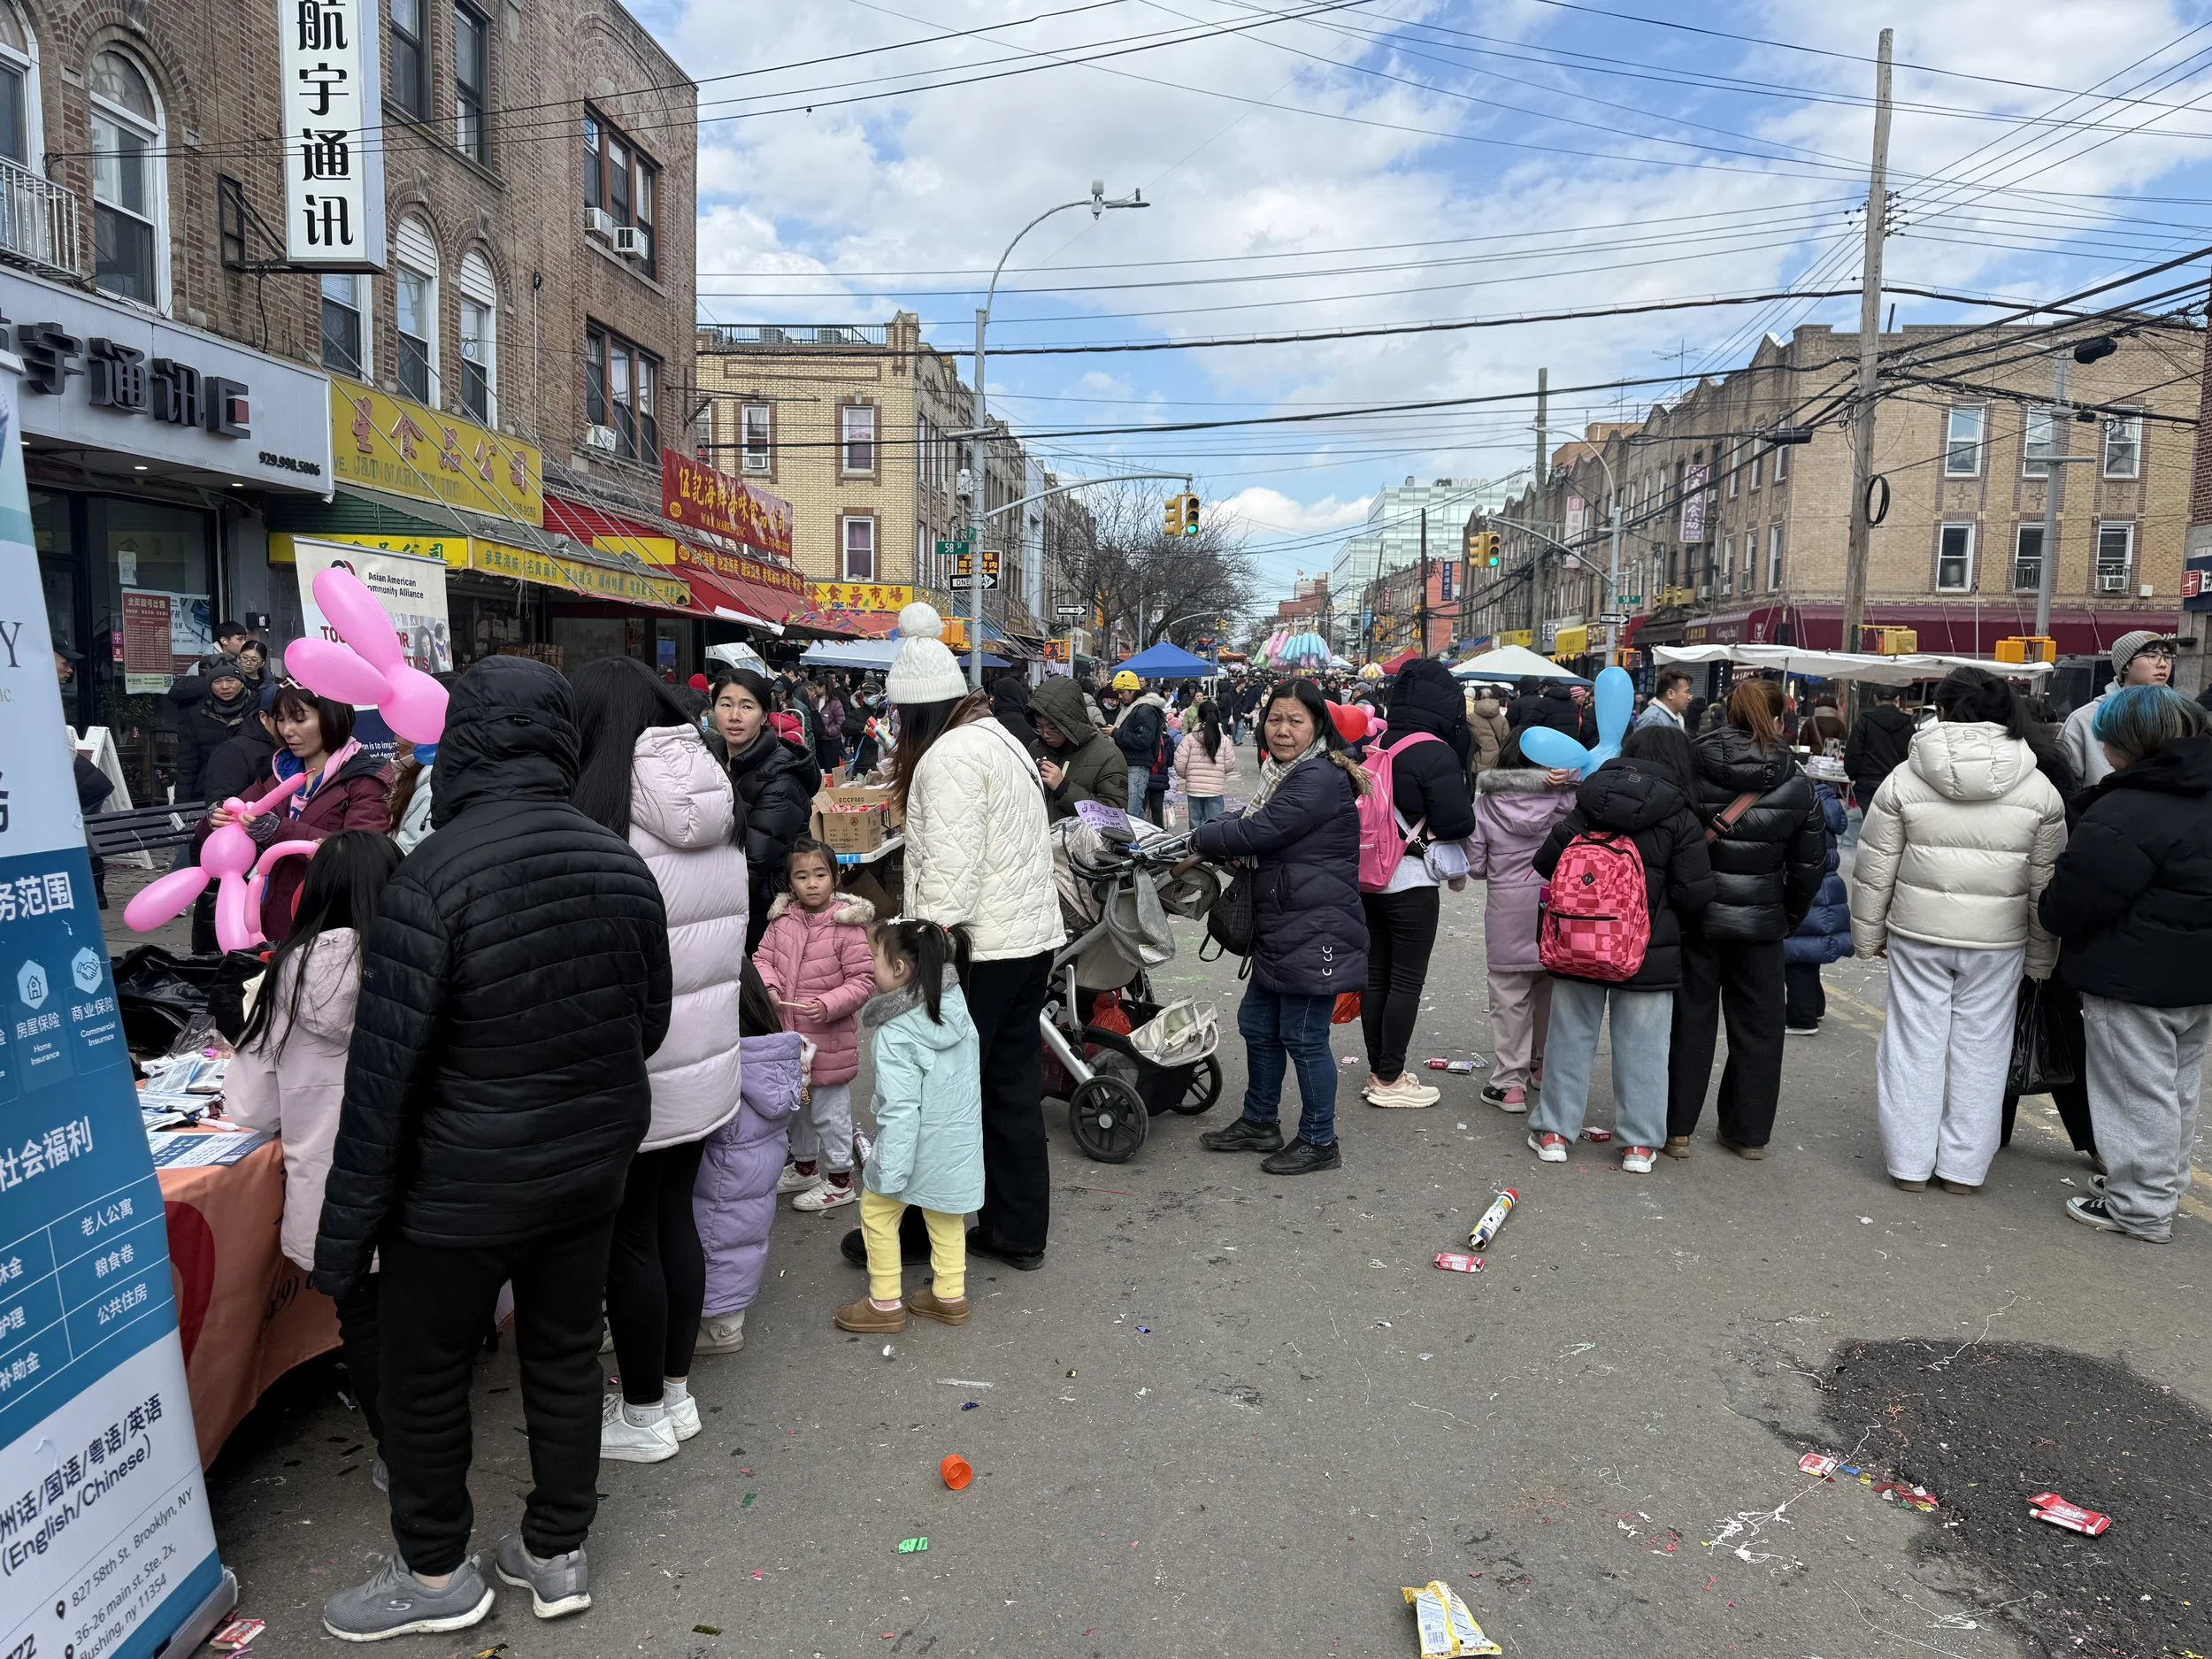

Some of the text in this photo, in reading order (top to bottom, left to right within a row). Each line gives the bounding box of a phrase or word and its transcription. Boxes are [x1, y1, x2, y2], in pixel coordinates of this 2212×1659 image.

[296, 0, 354, 247] 航宇通讯
[944, 542, 955, 553] 58
[363, 584, 424, 600] ommunity Alliance
[368, 572, 417, 588] Asian American
[16, 1011, 61, 1040] 房屋保险
[71, 996, 115, 1023] 商业保险
[33, 1042, 52, 1054] Home
[80, 1020, 117, 1038] Commercial
[0, 1116, 94, 1193] 社会福利
[81, 1197, 134, 1237] 老人公寓
[94, 1243, 134, 1279] 粮食卷
[96, 1283, 148, 1325] 公共住房
[2, 1433, 152, 1577] (English/Chinese)
[72, 1486, 194, 1608] 827 58th St. Brooklyn, NY
[74, 1607, 106, 1647] 36-26
[106, 1584, 133, 1617] main
[132, 1572, 144, 1591] st.
[144, 1556, 163, 1578] Ste.
[125, 1603, 138, 1625] ny
[137, 1571, 167, 1609] 11354
